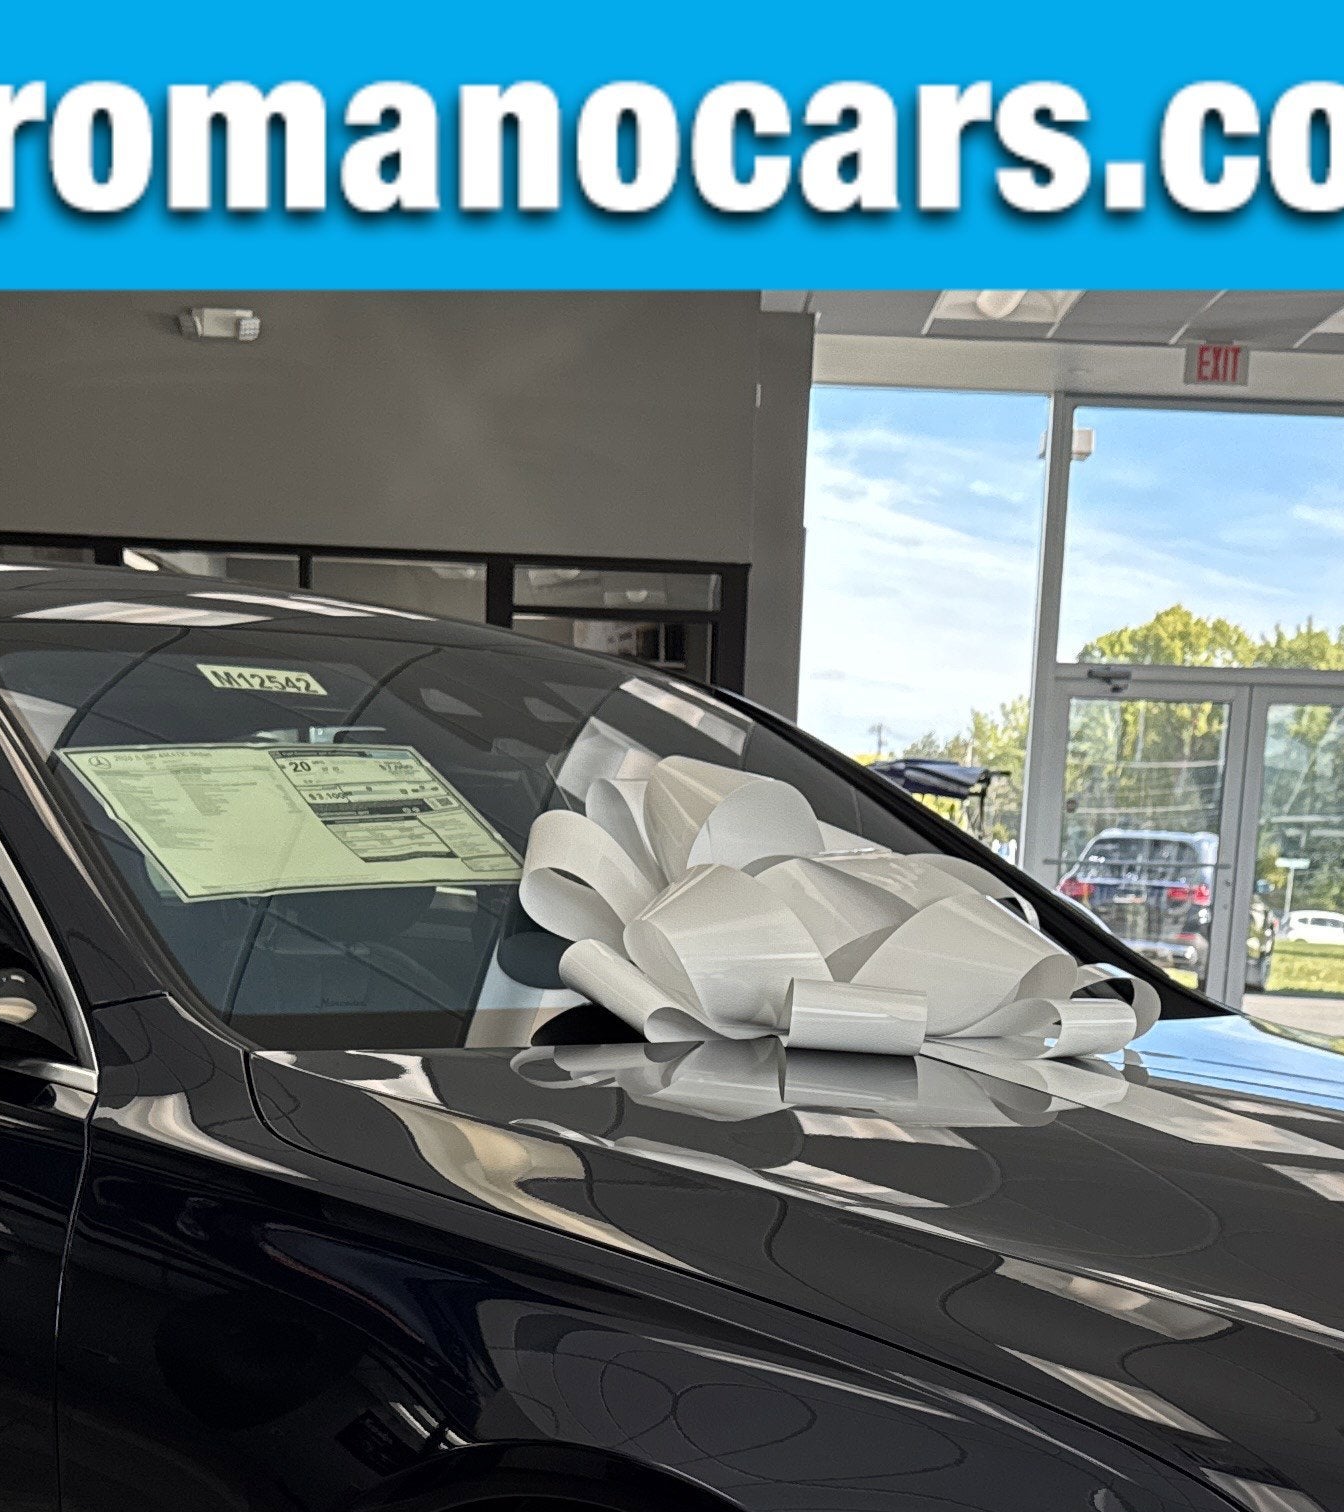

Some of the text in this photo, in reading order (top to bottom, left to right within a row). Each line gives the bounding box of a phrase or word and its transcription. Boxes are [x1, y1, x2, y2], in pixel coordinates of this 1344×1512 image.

[1197, 345, 1241, 382] EXIT
[211, 670, 319, 693] M12542
[289, 761, 312, 773] 20
